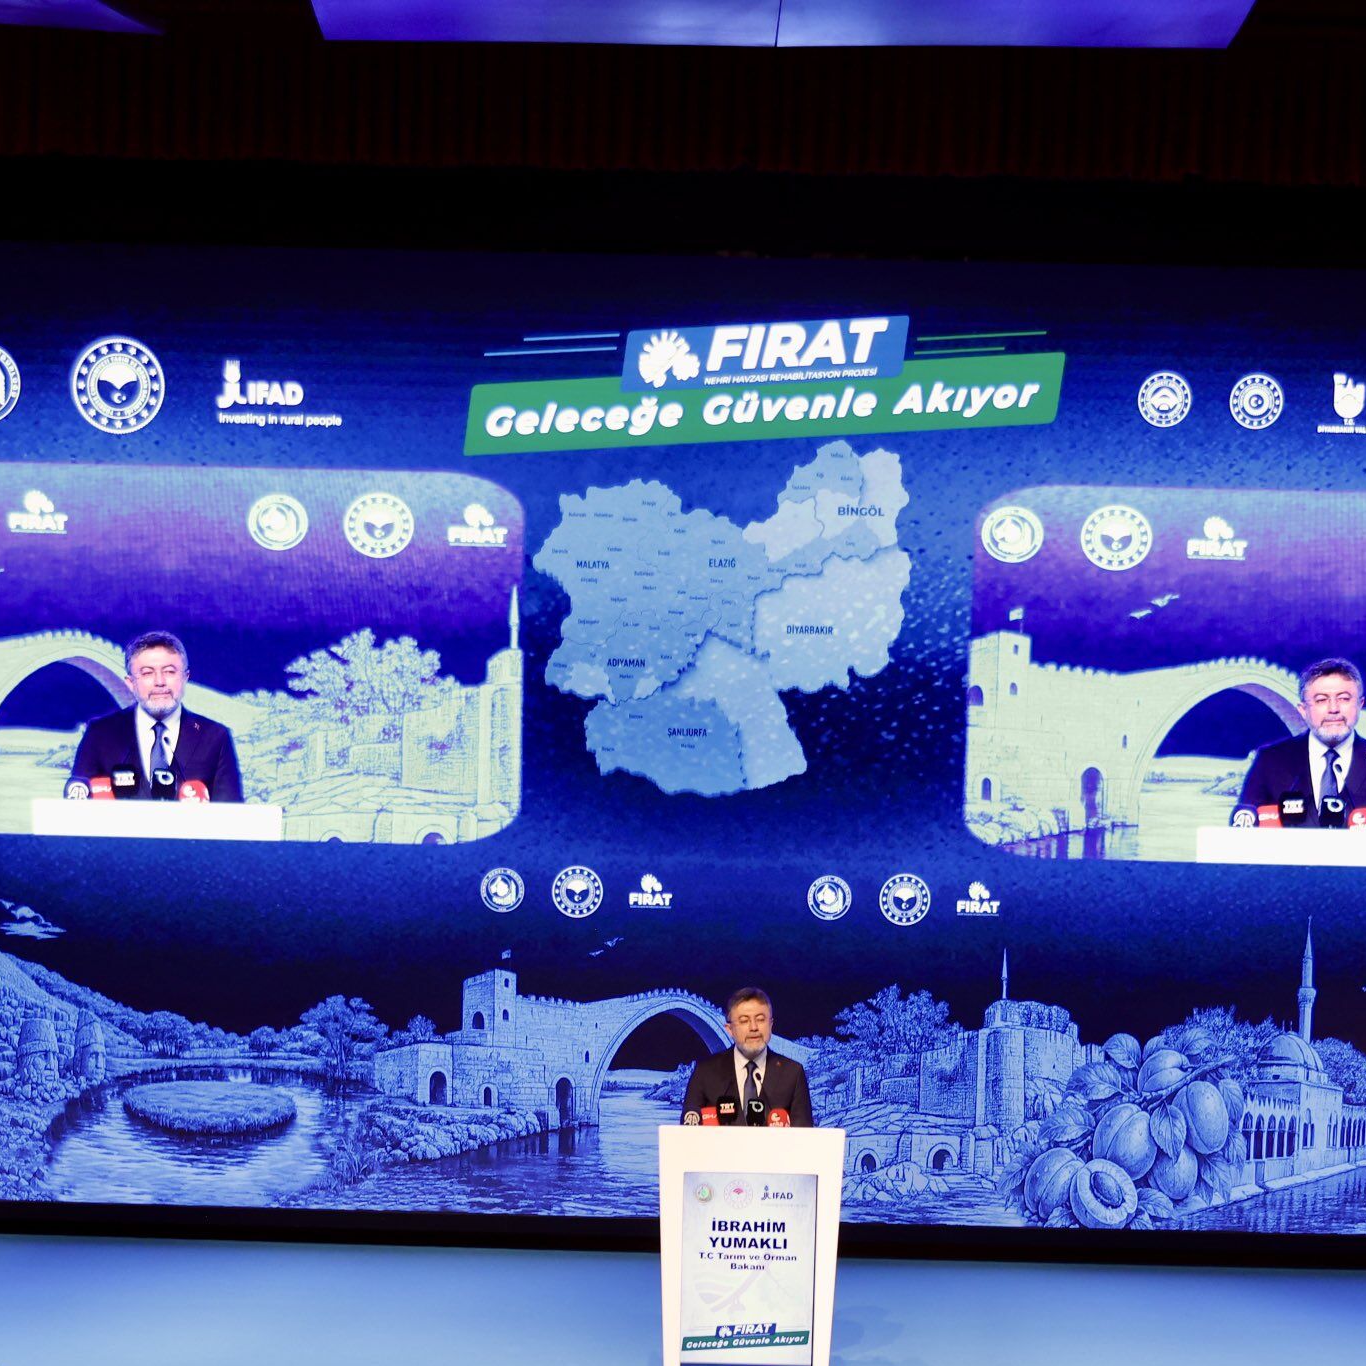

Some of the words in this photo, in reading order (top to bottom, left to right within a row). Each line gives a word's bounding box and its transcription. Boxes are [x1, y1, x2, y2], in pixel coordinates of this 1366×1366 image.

[706, 318, 889, 372] FIRAT
[247, 381, 304, 406] IFAD
[485, 396, 684, 437] Geleceğe
[702, 386, 878, 426] Güvenle
[892, 381, 1040, 418] Akıyor
[218, 412, 266, 427] Investing
[268, 413, 277, 425] in
[280, 414, 304, 425] rural
[306, 414, 342, 428] people
[837, 504, 885, 517] BİNGÖL
[8, 512, 69, 531] FIRAT
[447, 525, 508, 543] FIRAT
[1186, 538, 1248, 557] FIRAT
[576, 560, 610, 569] MALATYA
[708, 557, 736, 568] ELAZIĞ
[786, 624, 834, 635] DİYARBAKIR
[607, 658, 646, 667] ADIYAMAN
[667, 728, 707, 738] ŞANLIURFA
[628, 892, 673, 906] FIRAT
[956, 900, 1000, 913] FIRAT
[772, 1192, 793, 1200] IFAD
[711, 1217, 786, 1233] İBRAHİM
[709, 1236, 788, 1249] YUMAKLI
[718, 1252, 745, 1260] Tarım
[763, 1253, 797, 1261] Orman
[733, 1323, 773, 1335] FIRAT
